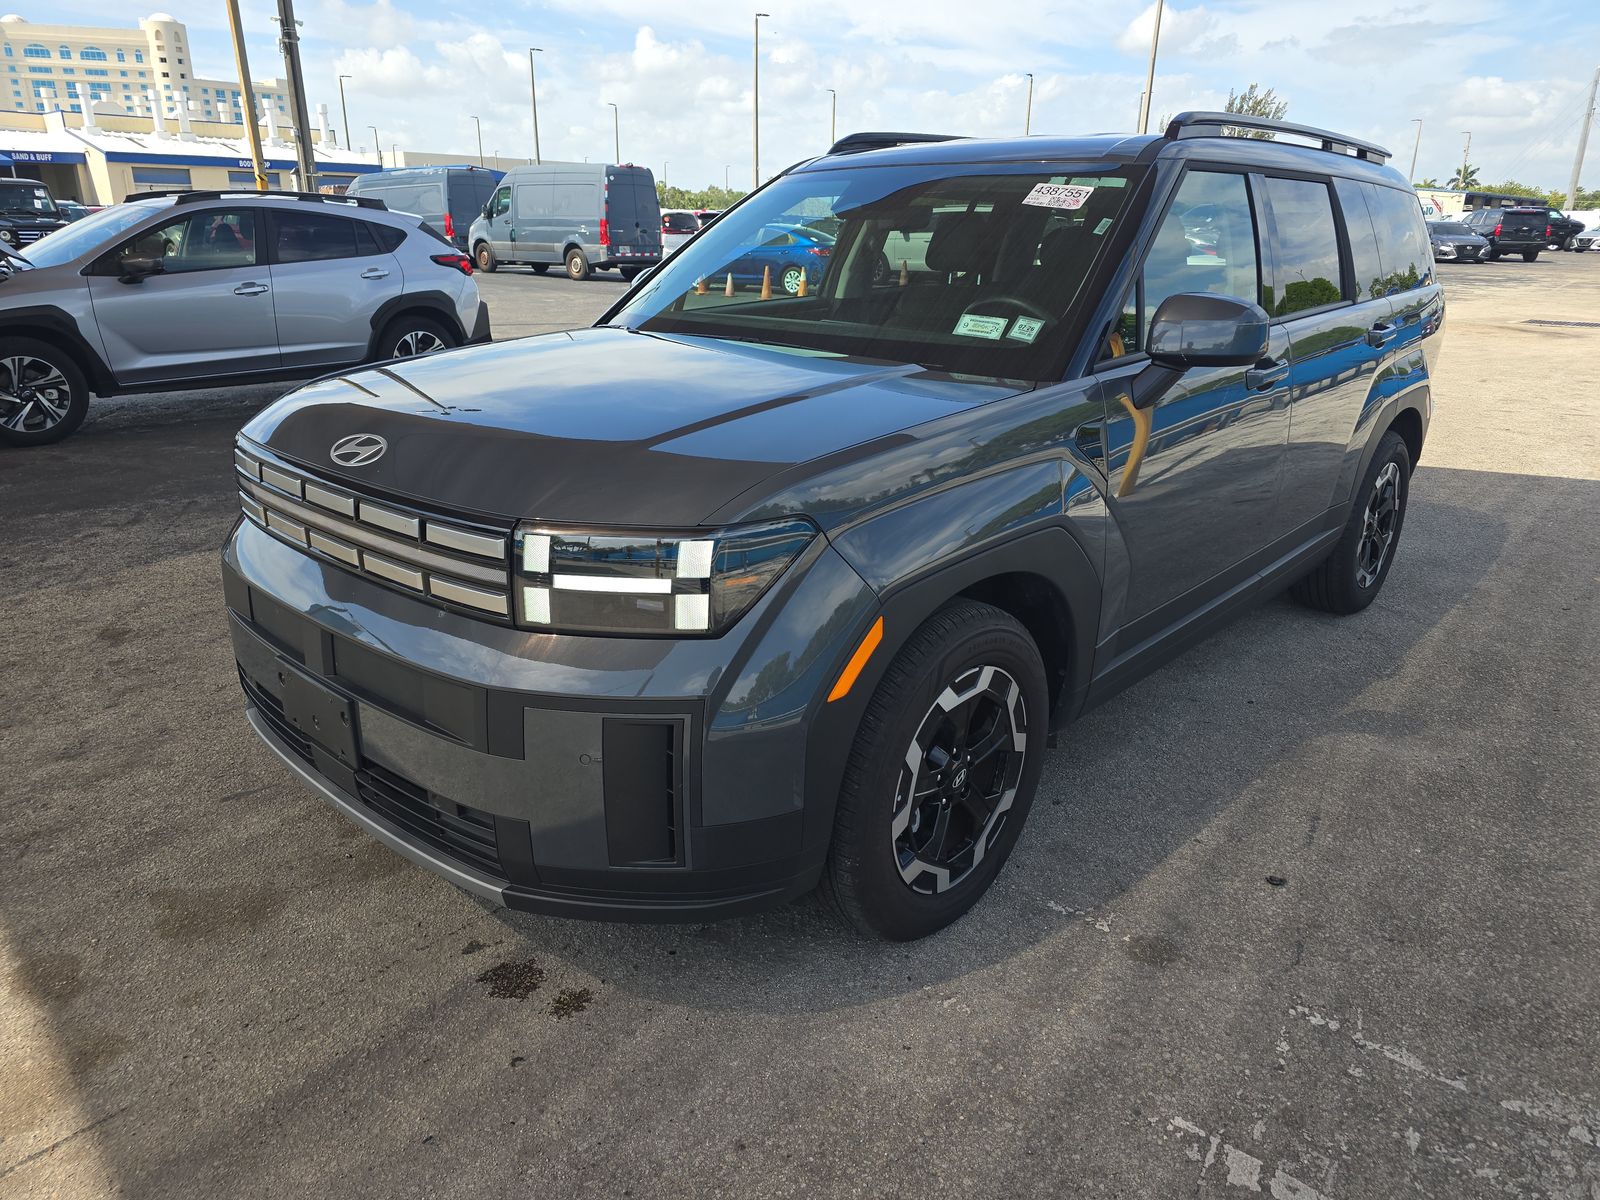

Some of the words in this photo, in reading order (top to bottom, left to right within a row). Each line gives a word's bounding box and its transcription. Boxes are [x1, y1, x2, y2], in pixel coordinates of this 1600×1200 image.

[11, 152, 29, 160] SAND
[30, 153, 36, 161] &
[36, 153, 52, 161] BUFF
[1034, 186, 1091, 199] 4387551
